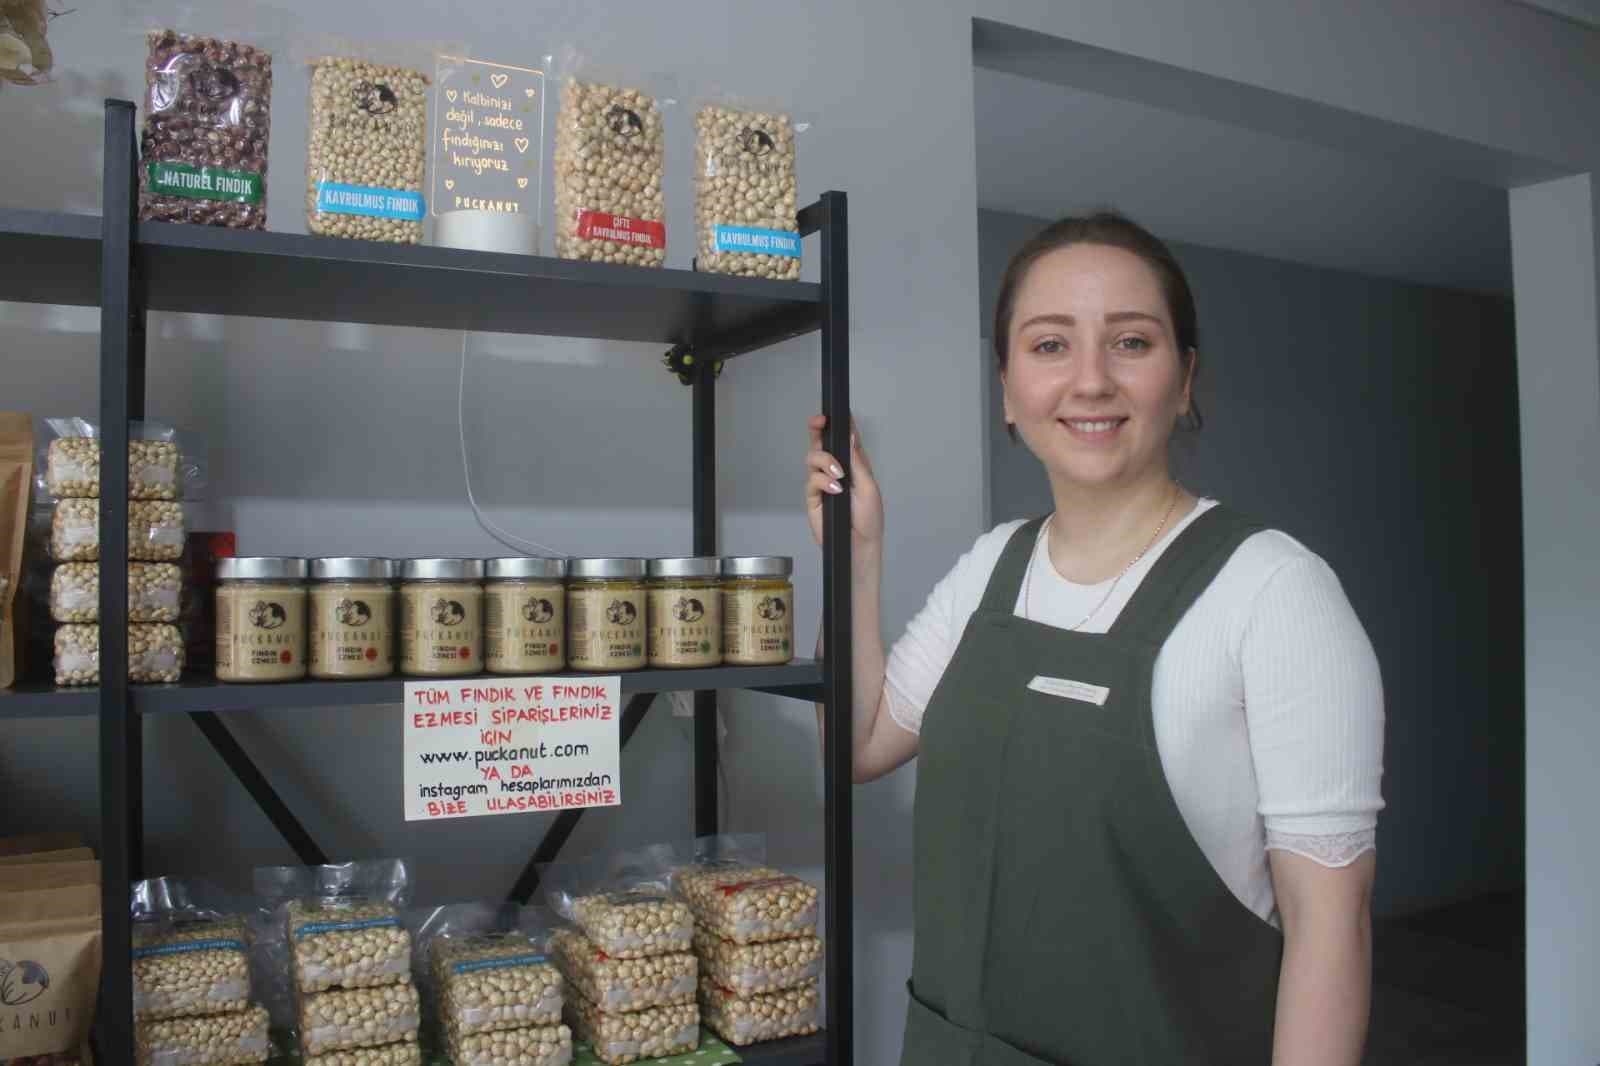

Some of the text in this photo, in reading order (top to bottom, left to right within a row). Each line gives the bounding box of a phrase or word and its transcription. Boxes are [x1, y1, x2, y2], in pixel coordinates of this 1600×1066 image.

[164, 170, 253, 195] NATUREL FINDIK
[387, 196, 419, 213] FINDIK
[414, 685, 607, 704] TÜM FINDIK VE FINDIK
[413, 708, 478, 728] EZMESİ
[481, 765, 534, 780] YA DA
[419, 782, 488, 800] instagram
